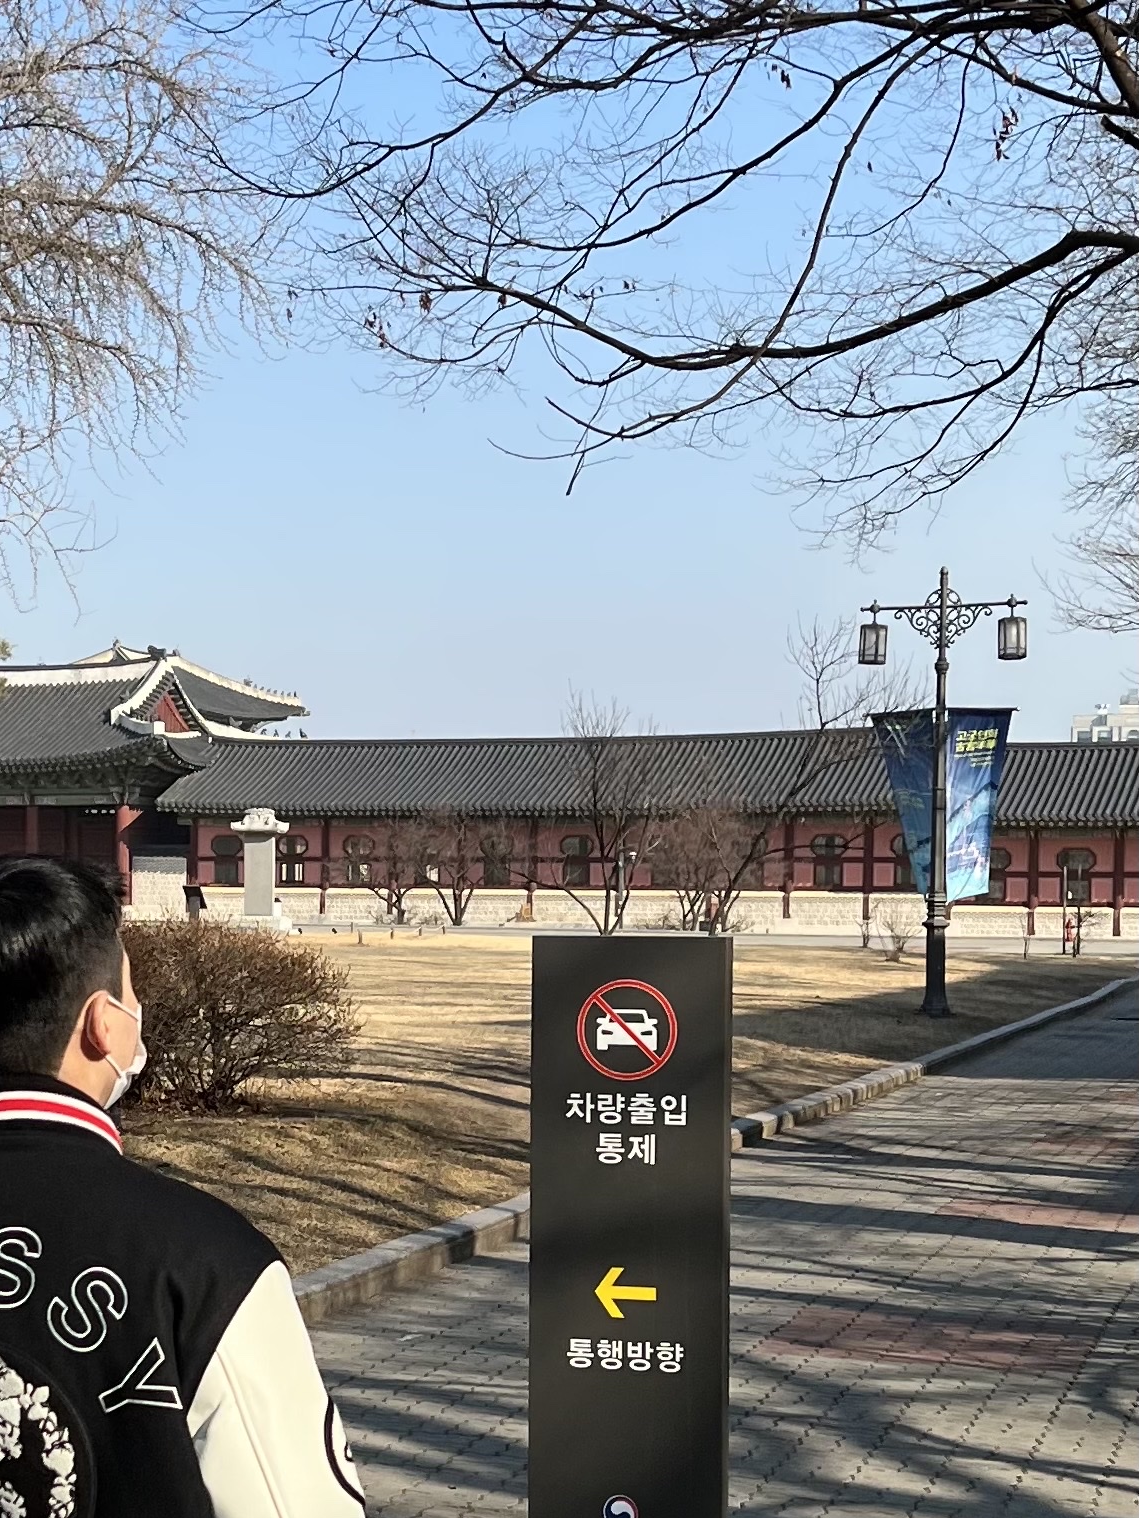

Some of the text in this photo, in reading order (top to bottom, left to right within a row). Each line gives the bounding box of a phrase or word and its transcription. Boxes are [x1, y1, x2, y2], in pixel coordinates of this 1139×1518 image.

[565, 1092, 687, 1126] 차량출입
[595, 1132, 656, 1166] 통제
[566, 1338, 684, 1373] 통행방향
